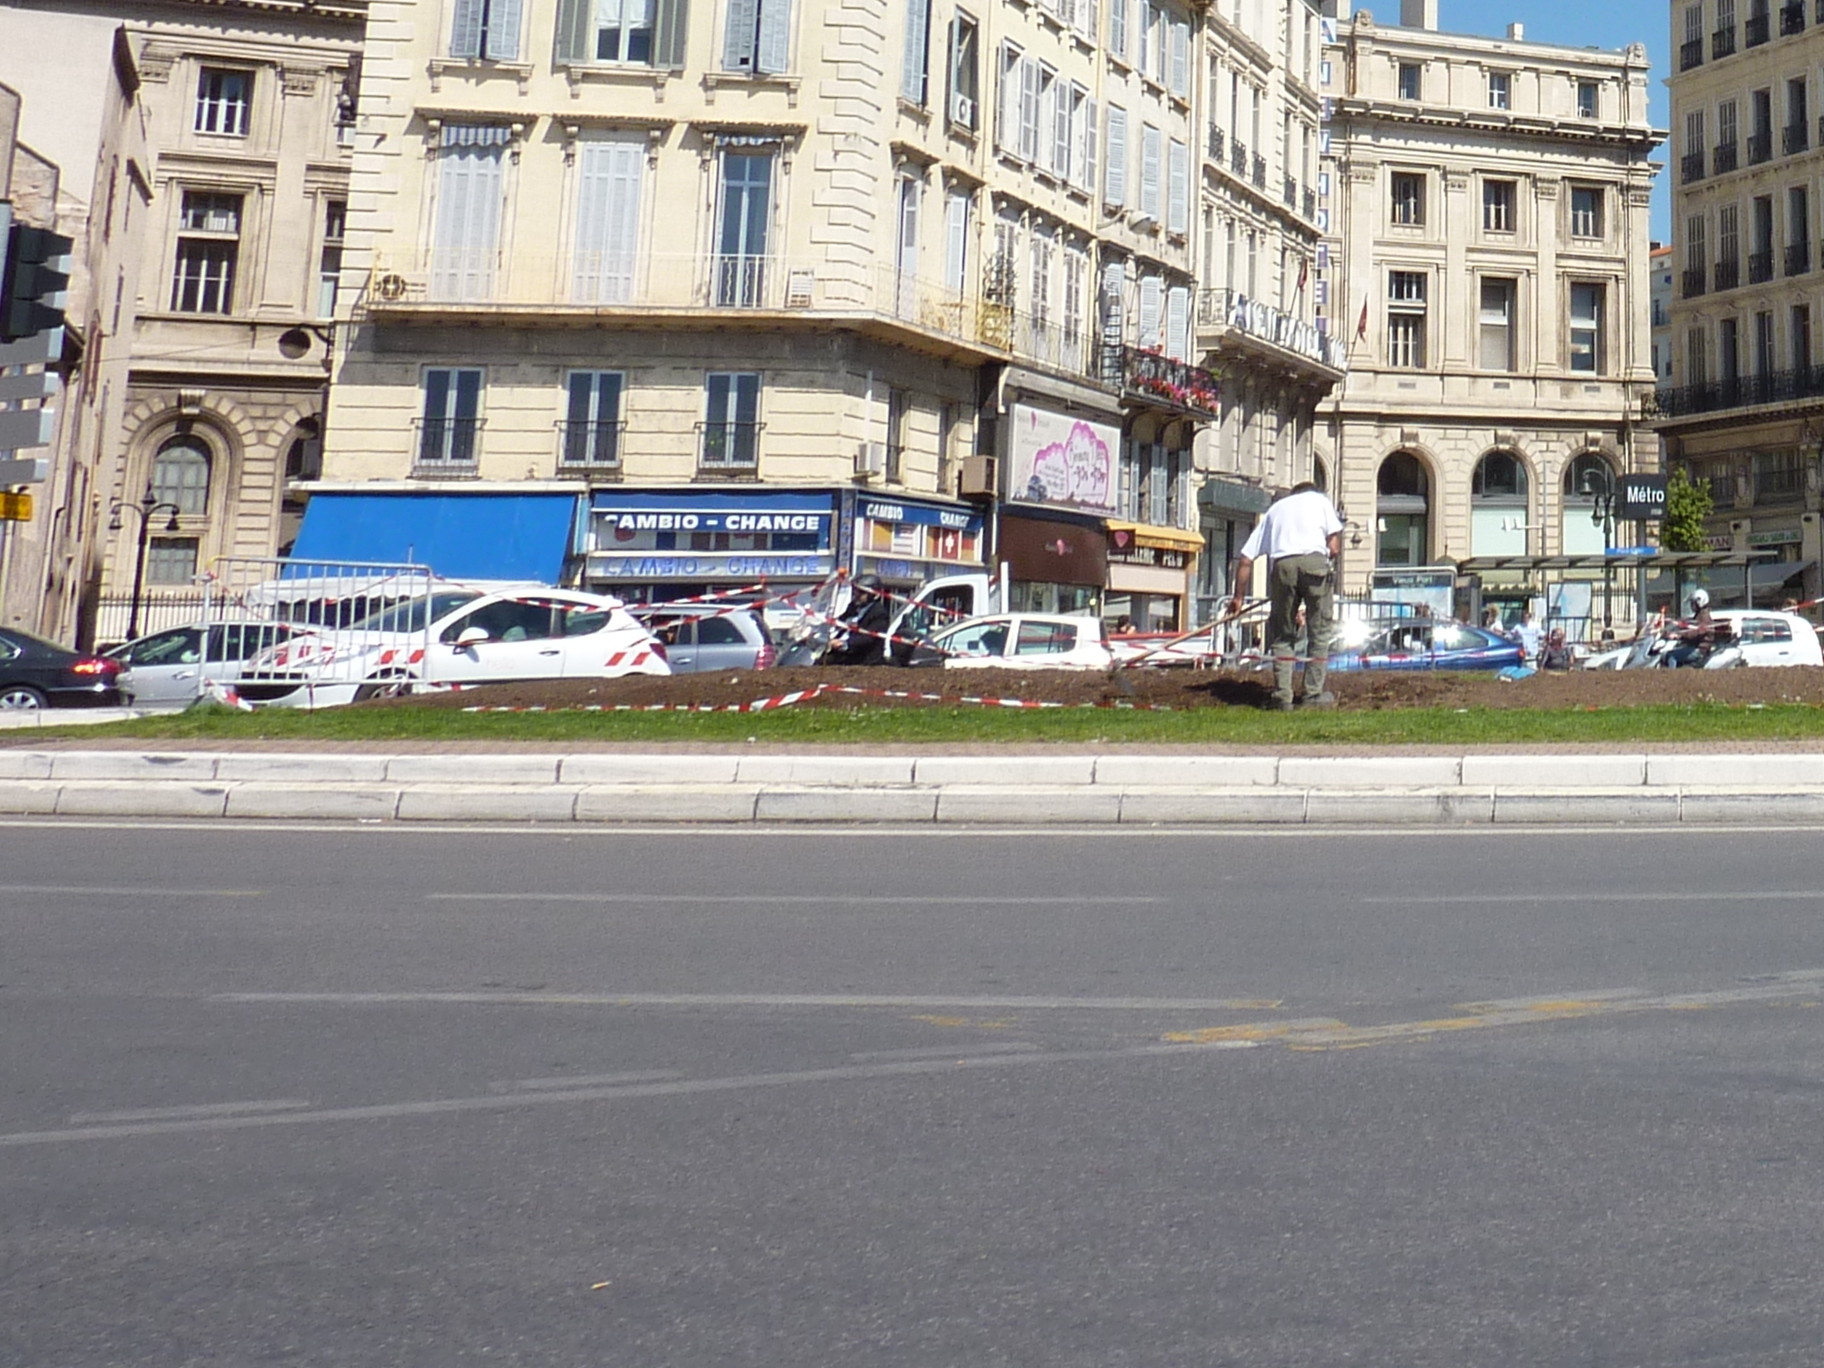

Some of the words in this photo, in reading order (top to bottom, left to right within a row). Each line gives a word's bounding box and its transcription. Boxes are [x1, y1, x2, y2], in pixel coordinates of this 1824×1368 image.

[1627, 486, 1665, 503] Métro
[725, 514, 820, 531] CHANGE
[866, 503, 904, 521] CAMBIO
[939, 511, 971, 528] CHANGE
[604, 557, 699, 575] CAMBIO
[726, 556, 821, 575] CHANGE
